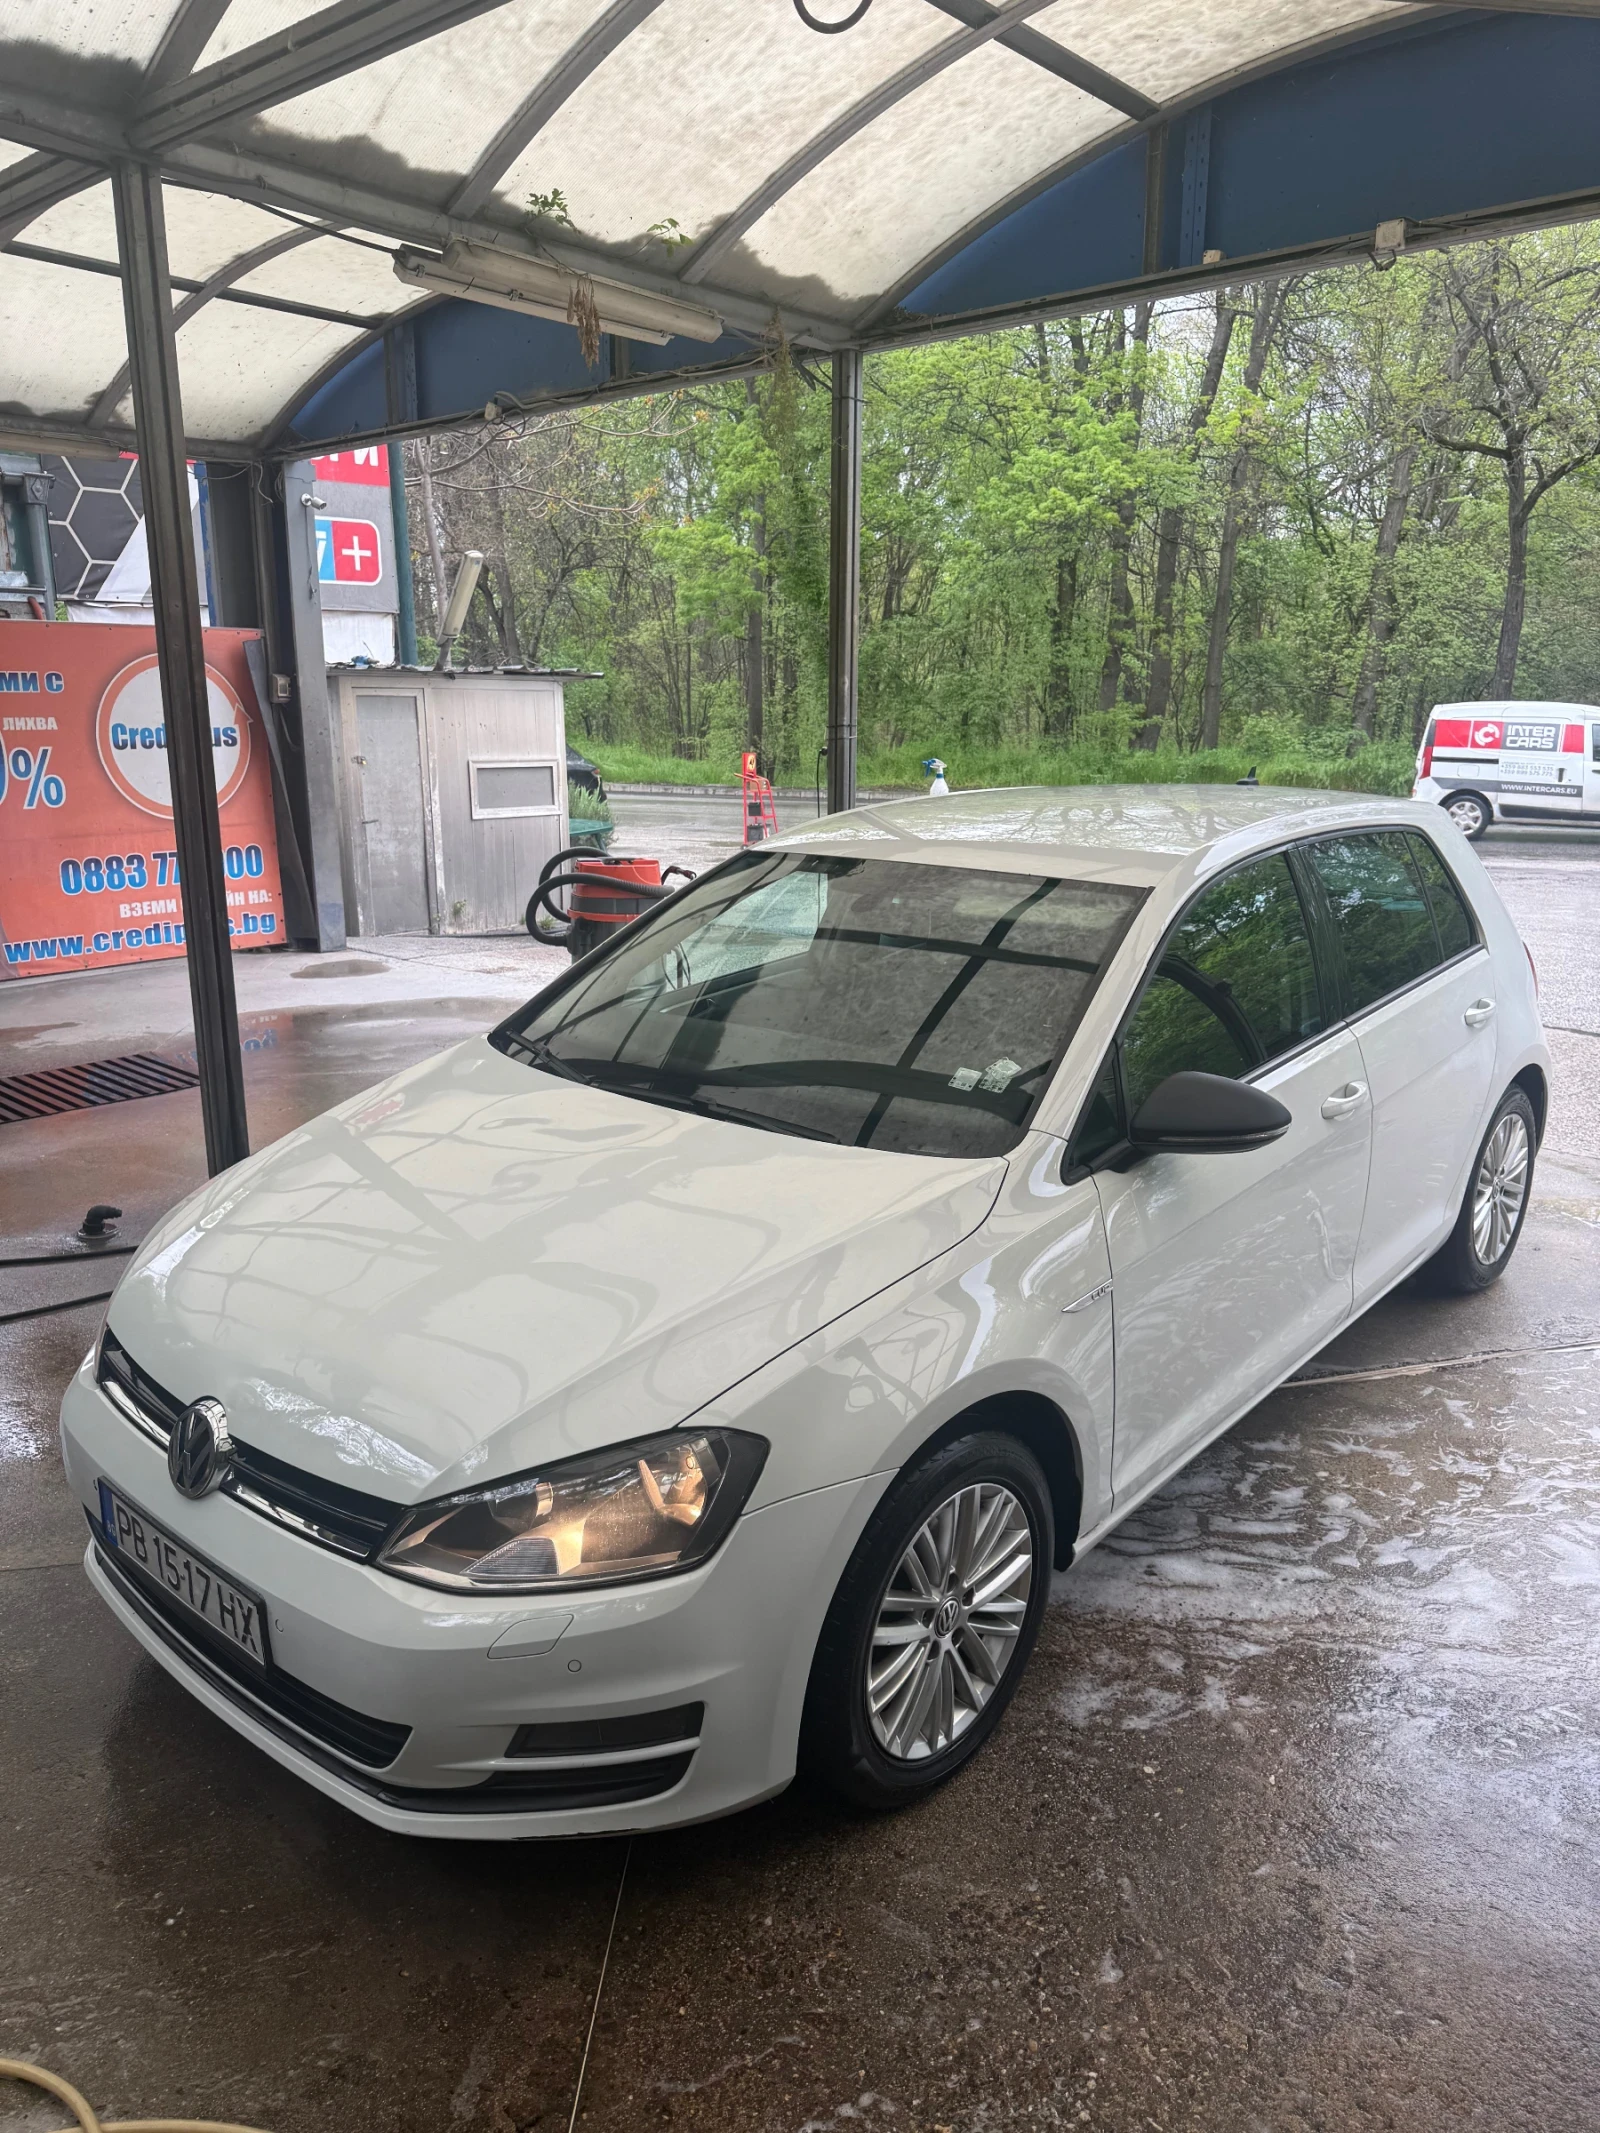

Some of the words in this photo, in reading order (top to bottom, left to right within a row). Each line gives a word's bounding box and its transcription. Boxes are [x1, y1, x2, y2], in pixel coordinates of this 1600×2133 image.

[3, 717, 58, 731] ЛИХВА
[1507, 725, 1556, 737] INTER
[1506, 737, 1554, 749] CARS
[1501, 783, 1577, 795] WWW.INTERCARS.EU
[60, 853, 148, 896] 0883
[119, 899, 177, 918] ВЗЕМИ
[248, 889, 273, 905] НА:
